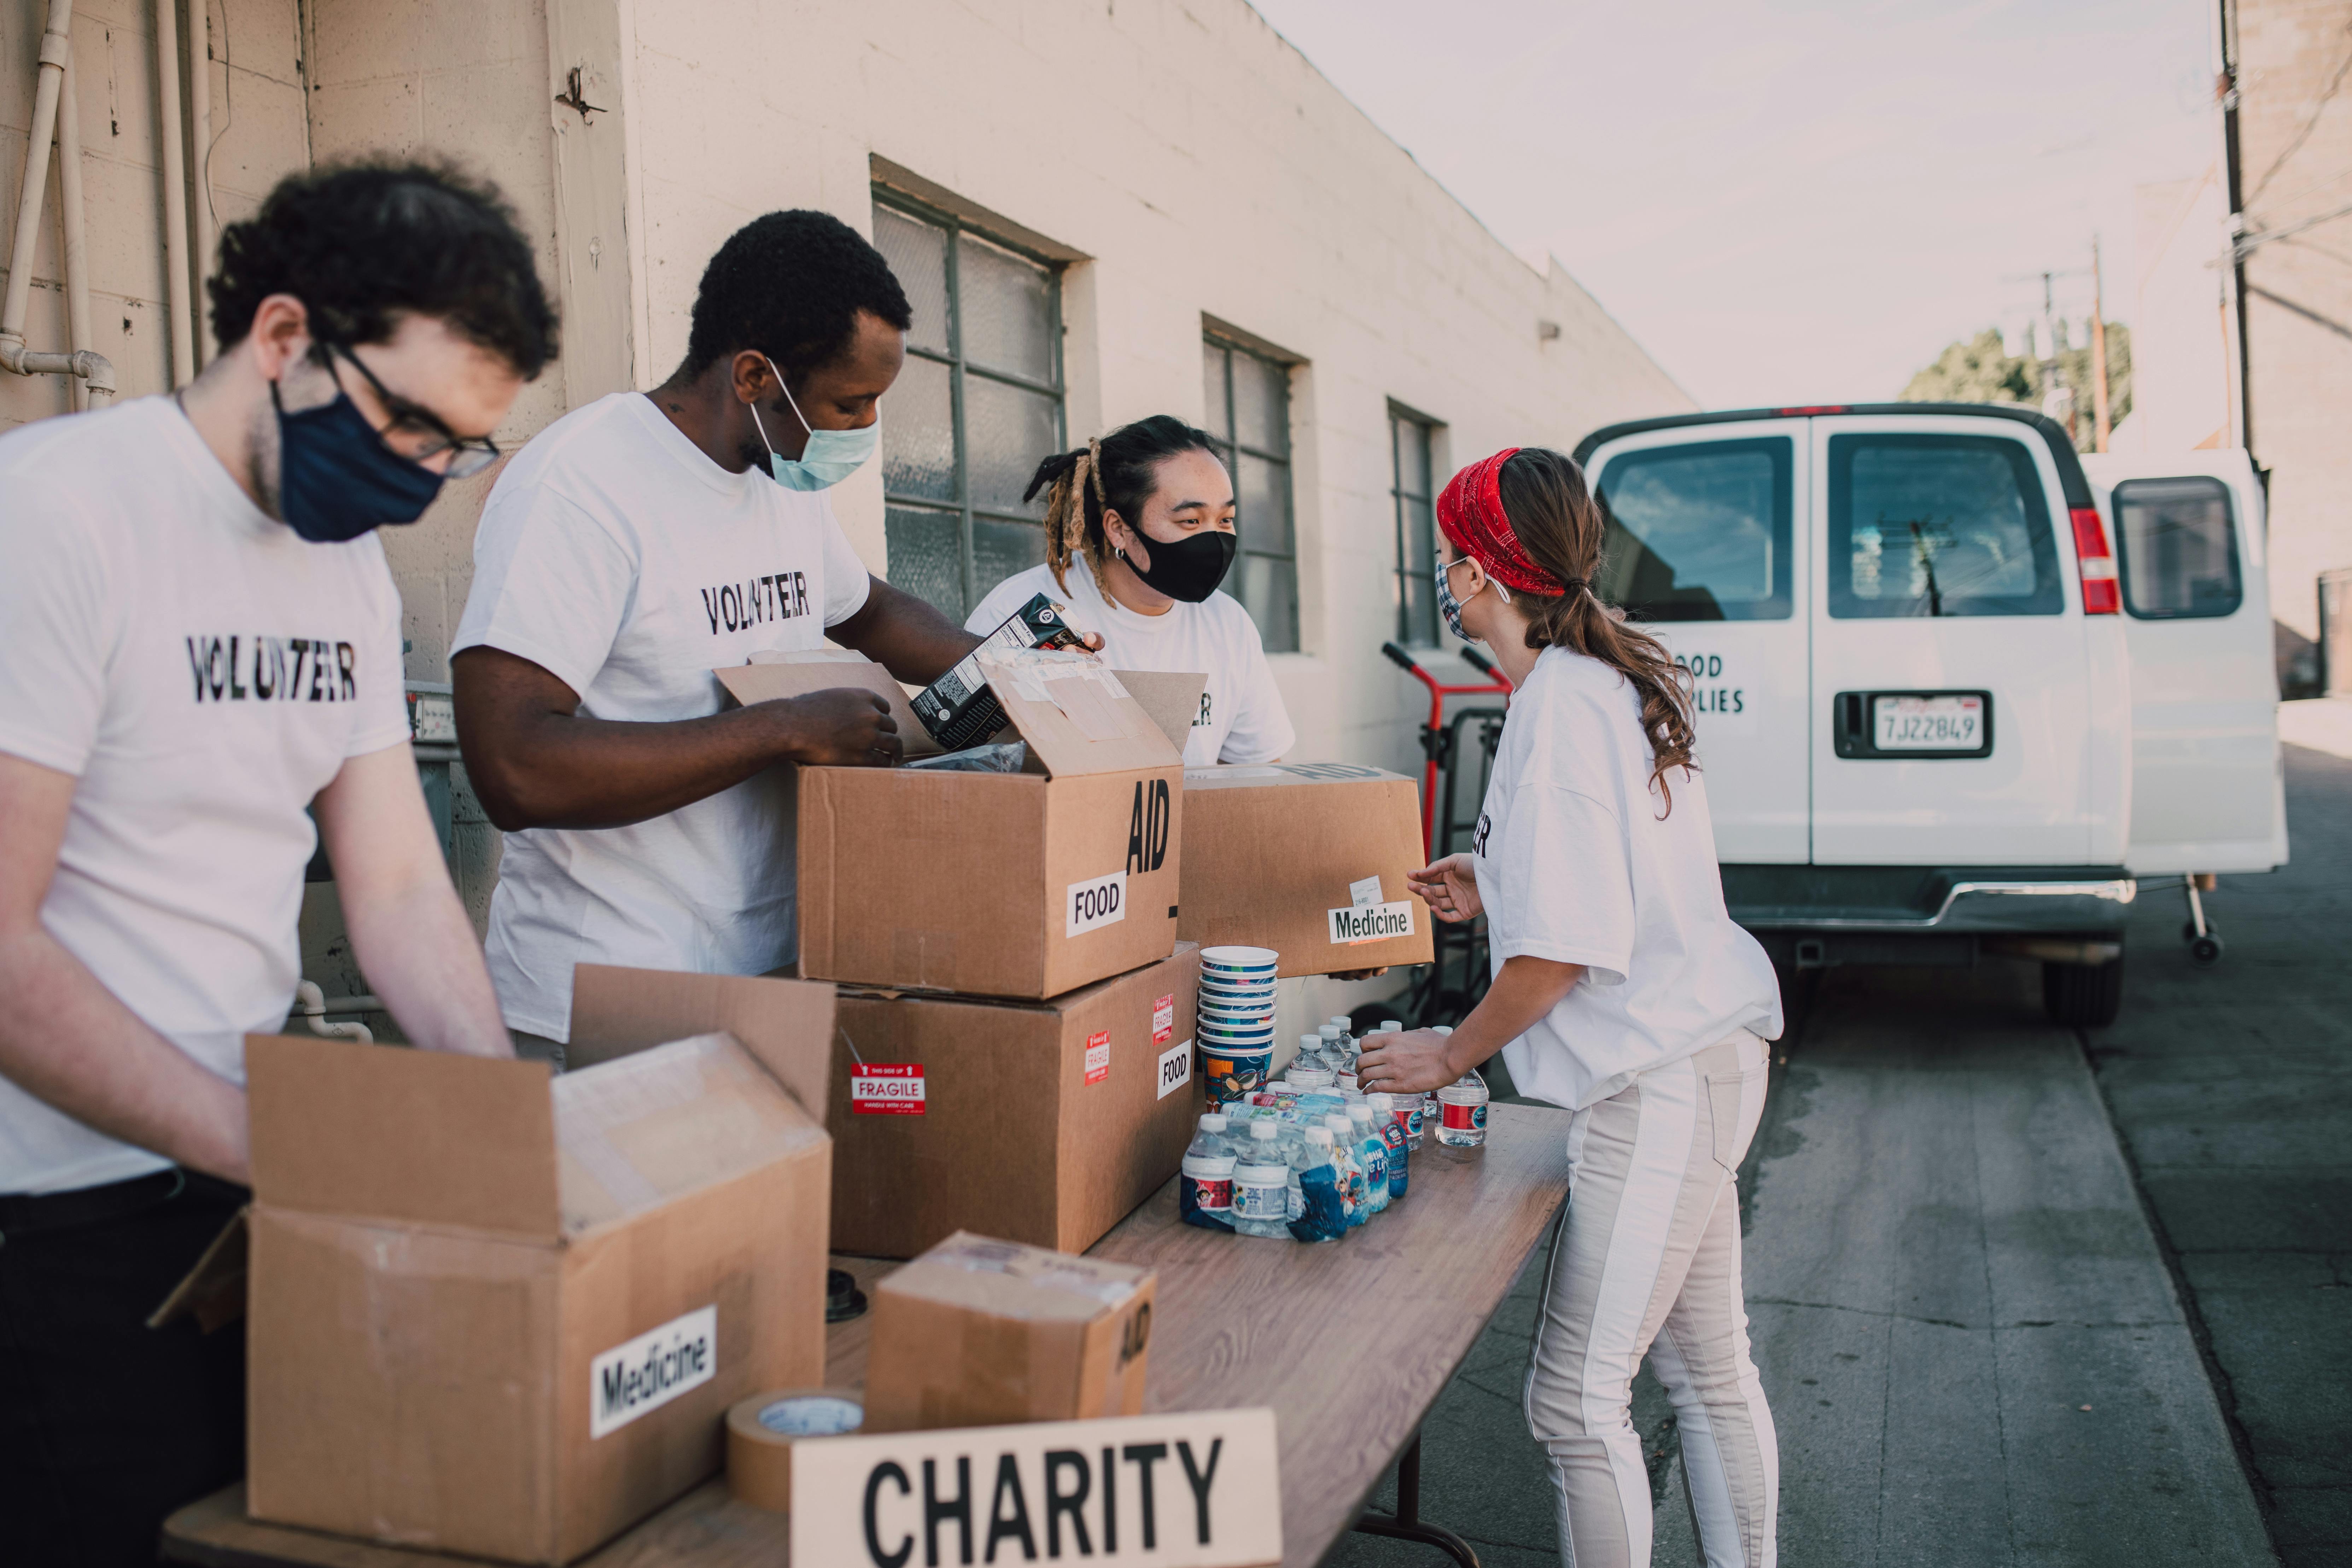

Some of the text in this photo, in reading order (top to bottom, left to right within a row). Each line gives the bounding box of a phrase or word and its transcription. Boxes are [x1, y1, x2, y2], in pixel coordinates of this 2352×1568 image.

[1001, 627, 1013, 641] Calories
[1015, 616, 1035, 642] Nutrition Facts
[1675, 655, 1722, 677] OOD
[1268, 763, 1382, 780] AID
[1126, 779, 1169, 876] AID
[1075, 883, 1119, 924] FOOD
[1335, 908, 1407, 938] Medicine
[1155, 1010, 1171, 1029] FRAGILE
[1088, 1049, 1108, 1068] FRAGILE
[1163, 1053, 1186, 1086] FOOD
[859, 1082, 919, 1096] FRAGILE
[600, 1332, 707, 1420] Medicine
[864, 1438, 1223, 1568] CHARITY
